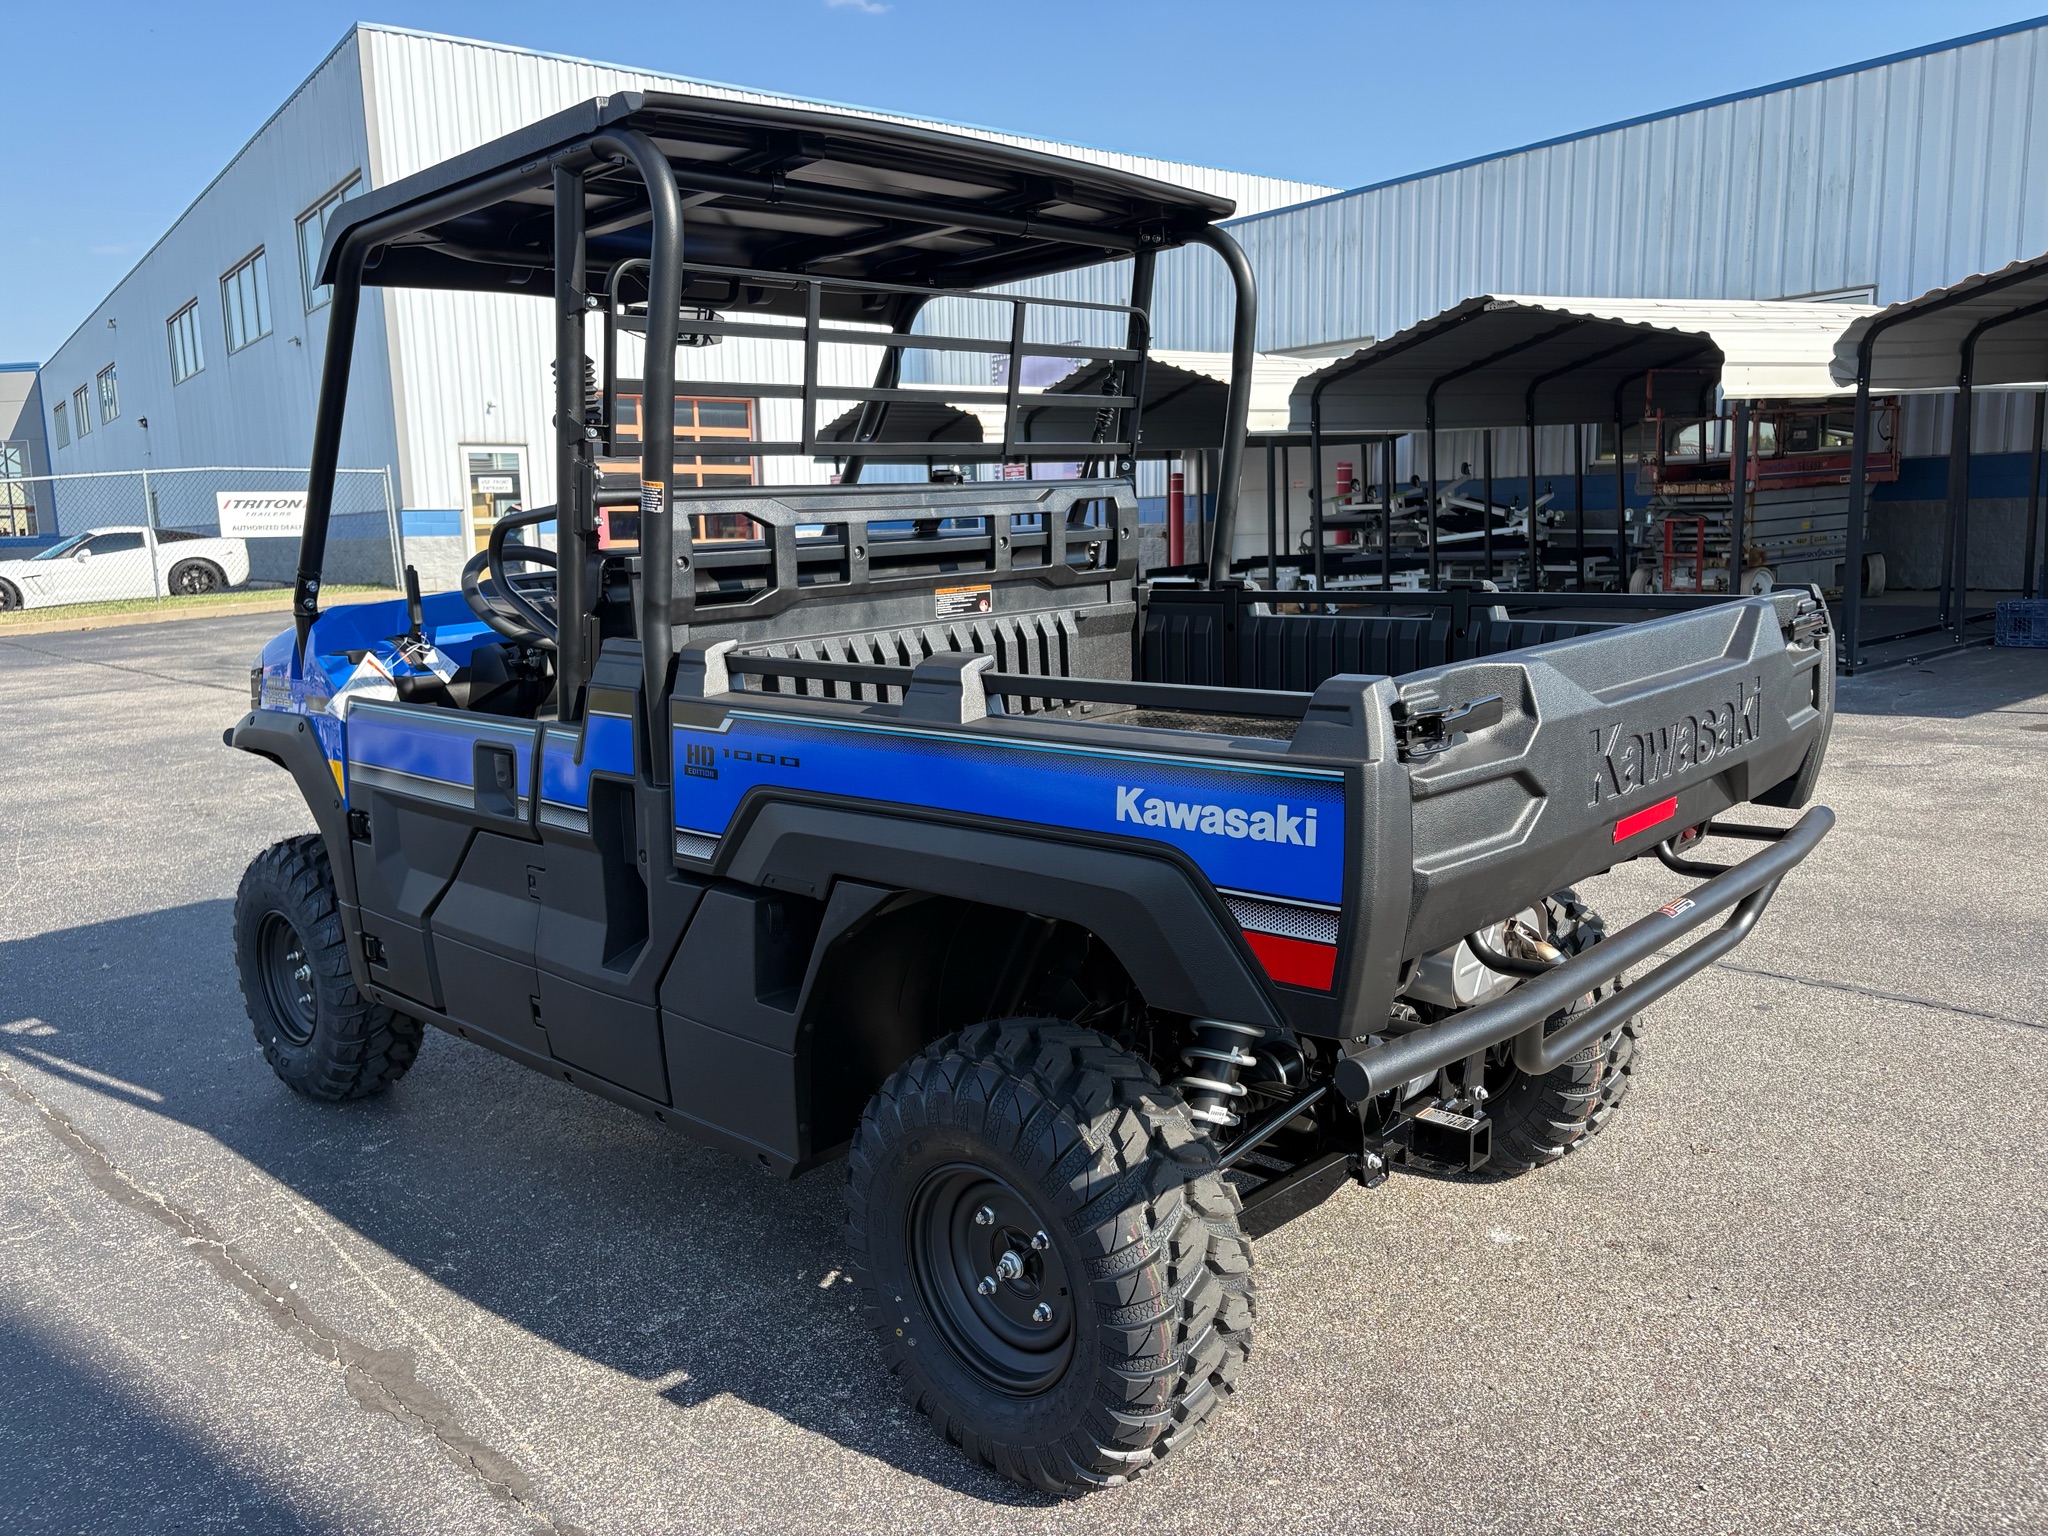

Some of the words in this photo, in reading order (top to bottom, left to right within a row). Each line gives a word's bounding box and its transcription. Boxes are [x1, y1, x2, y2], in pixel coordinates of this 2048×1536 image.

[233, 499, 303, 509] TRITON
[232, 524, 279, 532] AUTHORIZED
[1587, 676, 1762, 809] Kawasaki
[686, 744, 715, 766] HD
[723, 748, 800, 768] 1000
[688, 767, 715, 778] EDITION
[1115, 785, 1318, 848] Kawasaki
